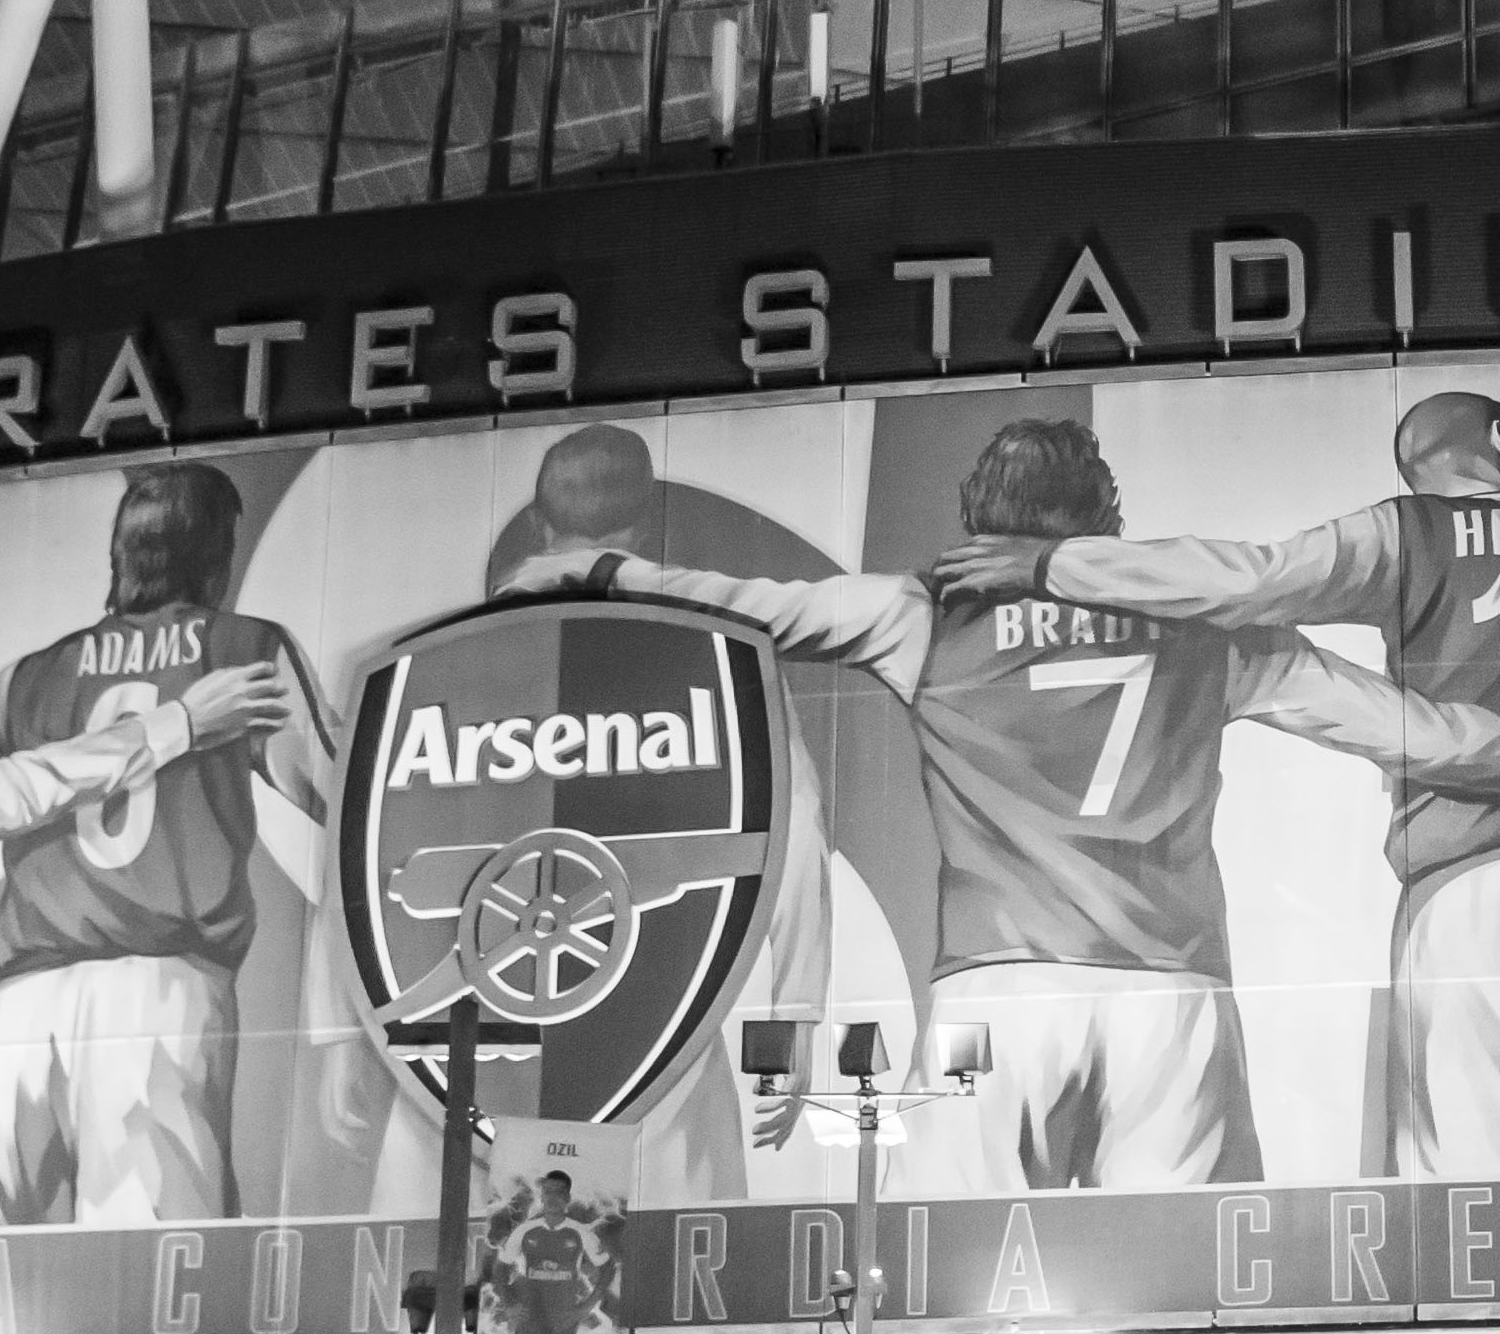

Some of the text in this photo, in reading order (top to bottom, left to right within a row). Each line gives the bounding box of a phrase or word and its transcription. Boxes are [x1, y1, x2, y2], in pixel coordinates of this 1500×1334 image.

[77, 619, 206, 678] ADAMS
[386, 686, 720, 788] Arsenal
[1028, 654, 1157, 816] 7
